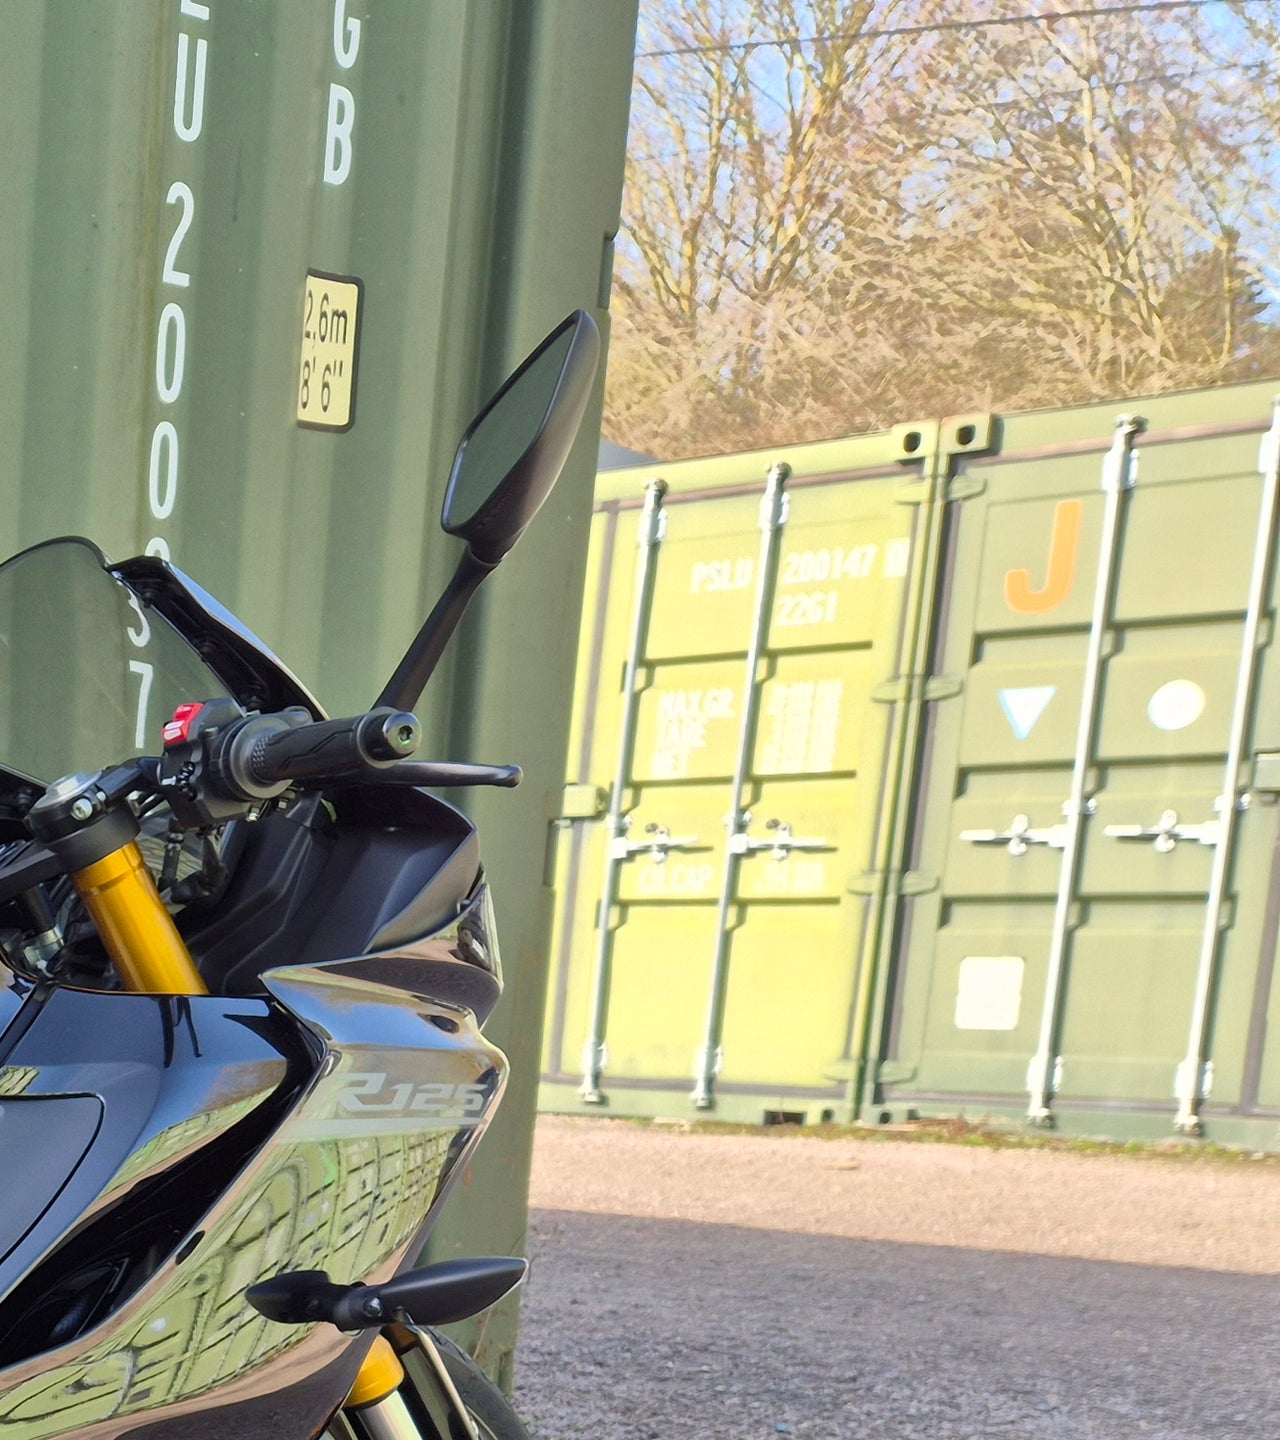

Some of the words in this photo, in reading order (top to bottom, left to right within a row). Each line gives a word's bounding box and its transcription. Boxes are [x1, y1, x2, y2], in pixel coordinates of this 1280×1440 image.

[173, 0, 209, 142] U
[323, 0, 361, 186] GB
[690, 556, 754, 594] PSLU
[781, 543, 879, 586] 200147
[1004, 499, 1083, 613] J
[339, 1071, 489, 1114] R125
